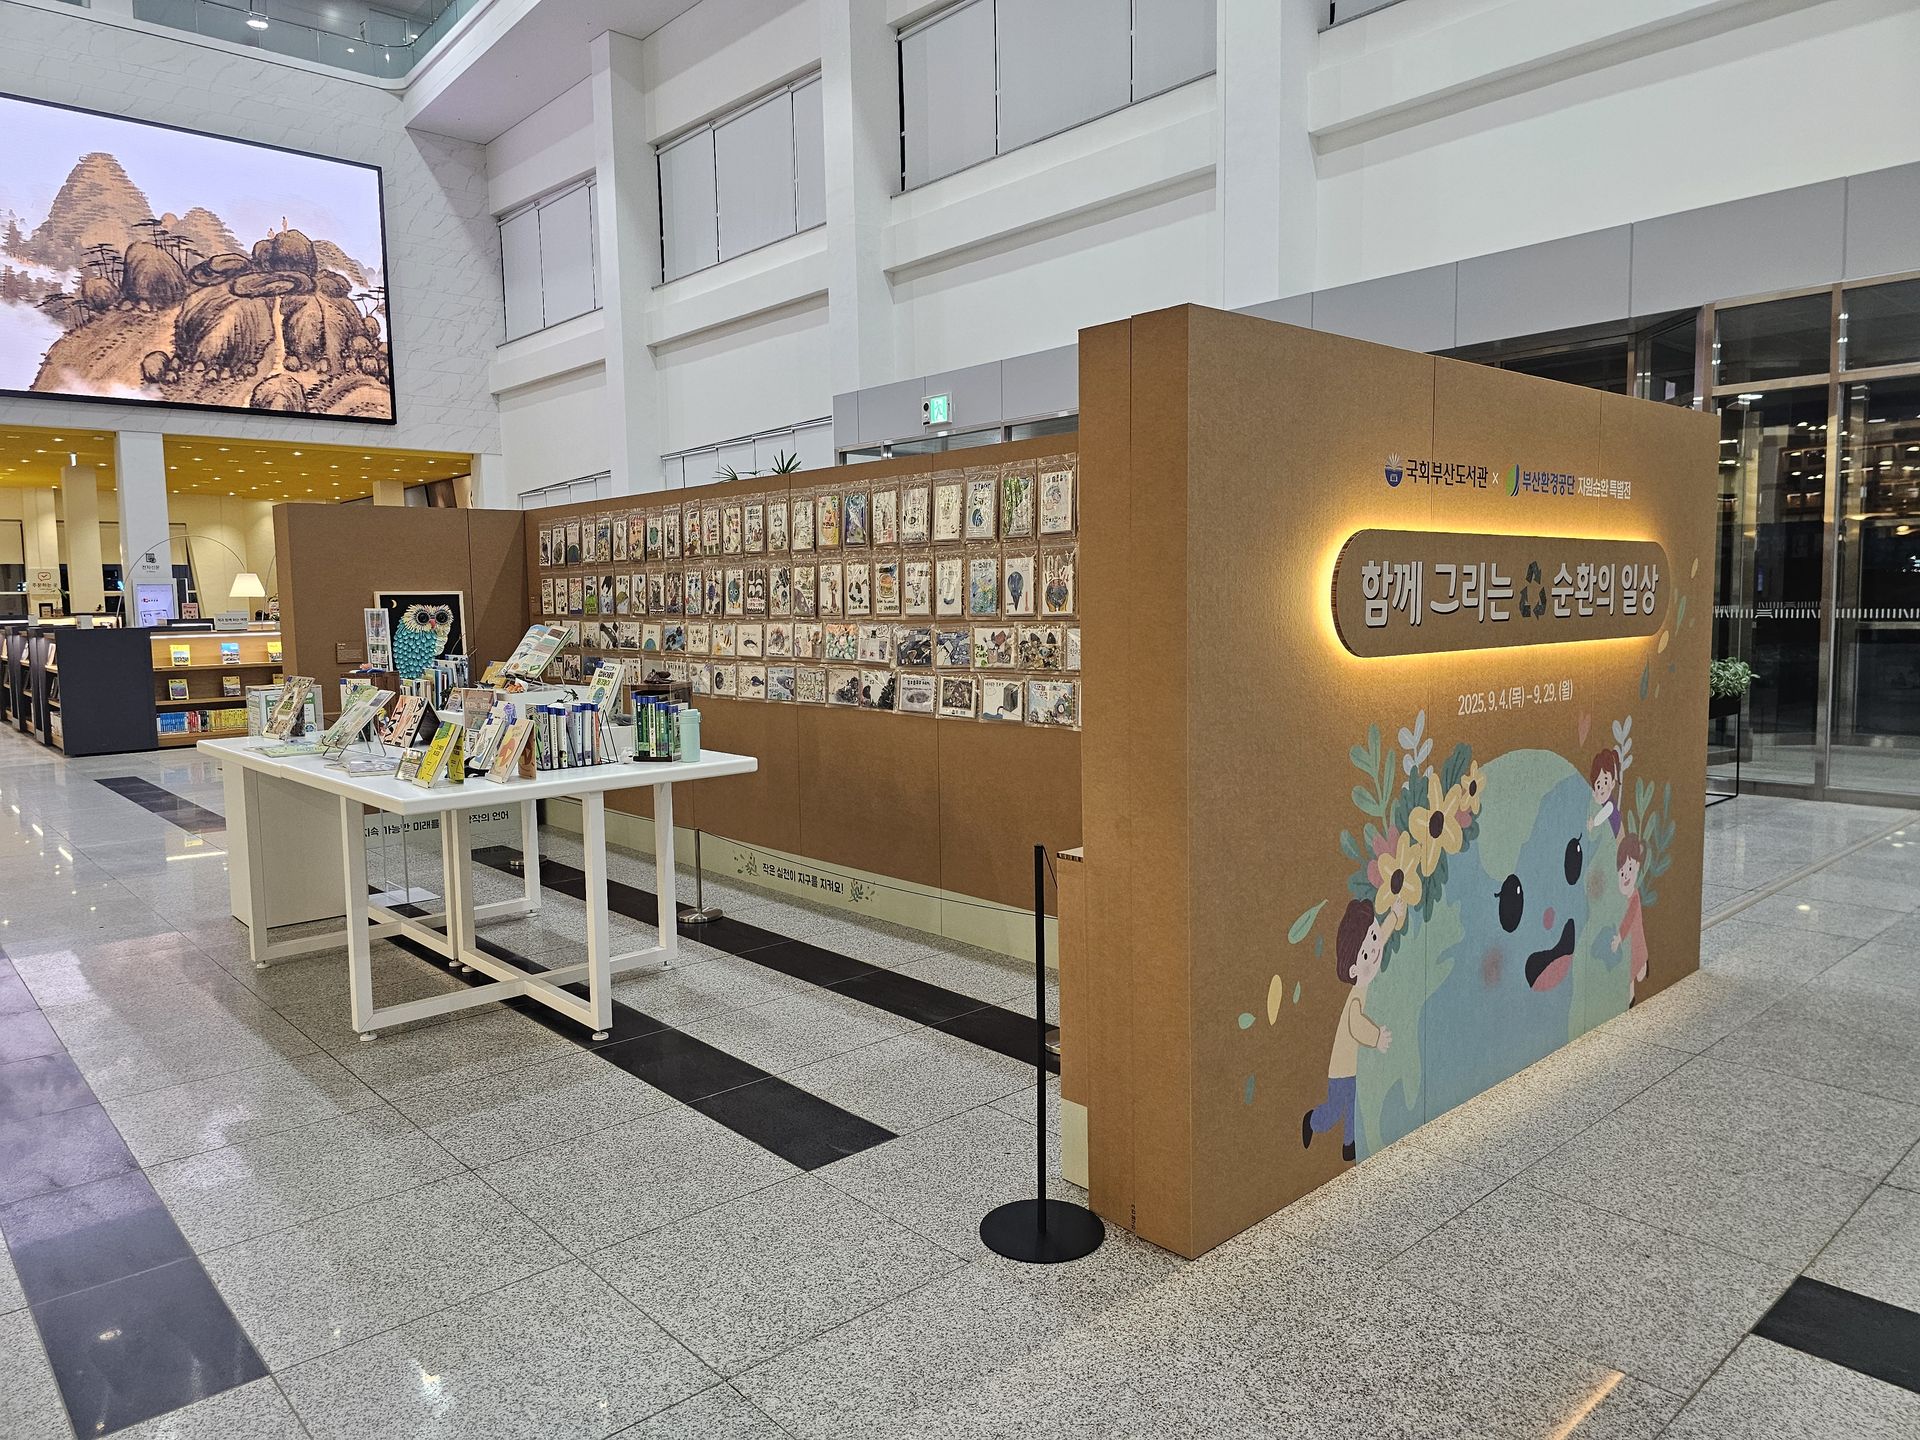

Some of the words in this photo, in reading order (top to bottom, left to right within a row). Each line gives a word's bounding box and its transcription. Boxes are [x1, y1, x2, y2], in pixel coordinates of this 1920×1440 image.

[1405, 459, 1488, 489] 국회부산도서관
[1522, 470, 1576, 496] 부산환경공단
[1577, 476, 1609, 498] 자원순환
[1609, 478, 1632, 500] 특별전
[1361, 560, 1424, 627] 함께
[1430, 561, 1514, 623] 그리는
[1551, 562, 1616, 618] 순환의
[1621, 563, 1660, 616] 일상
[413, 819, 440, 831] 미래를
[492, 810, 509, 821] 언어
[762, 862, 776, 877] 작은
[777, 866, 796, 882] 실천이
[798, 872, 818, 889] 지구를
[820, 878, 844, 895] 지켜요!
